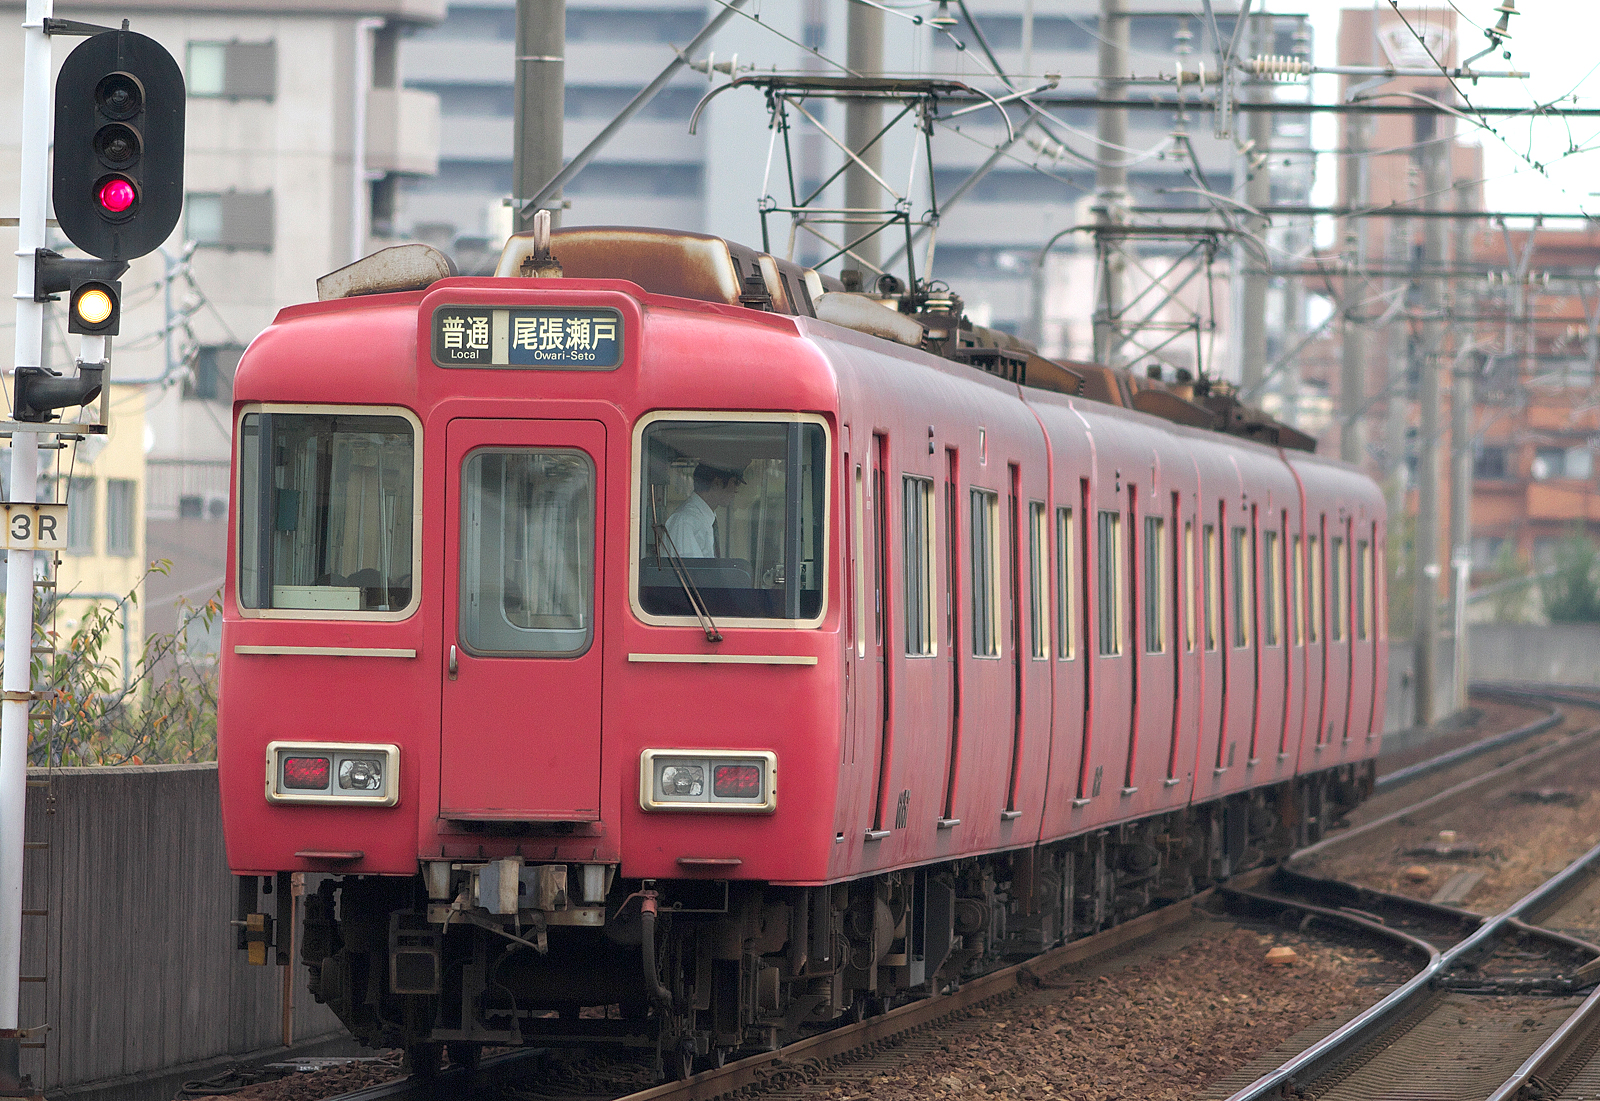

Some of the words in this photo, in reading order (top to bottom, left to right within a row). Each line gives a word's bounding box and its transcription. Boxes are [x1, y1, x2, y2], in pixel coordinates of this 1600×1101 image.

[442, 316, 489, 349] 普通
[512, 317, 617, 350] 尾張瀬戸
[451, 349, 479, 359] Local
[534, 350, 595, 361] Owari-Seto
